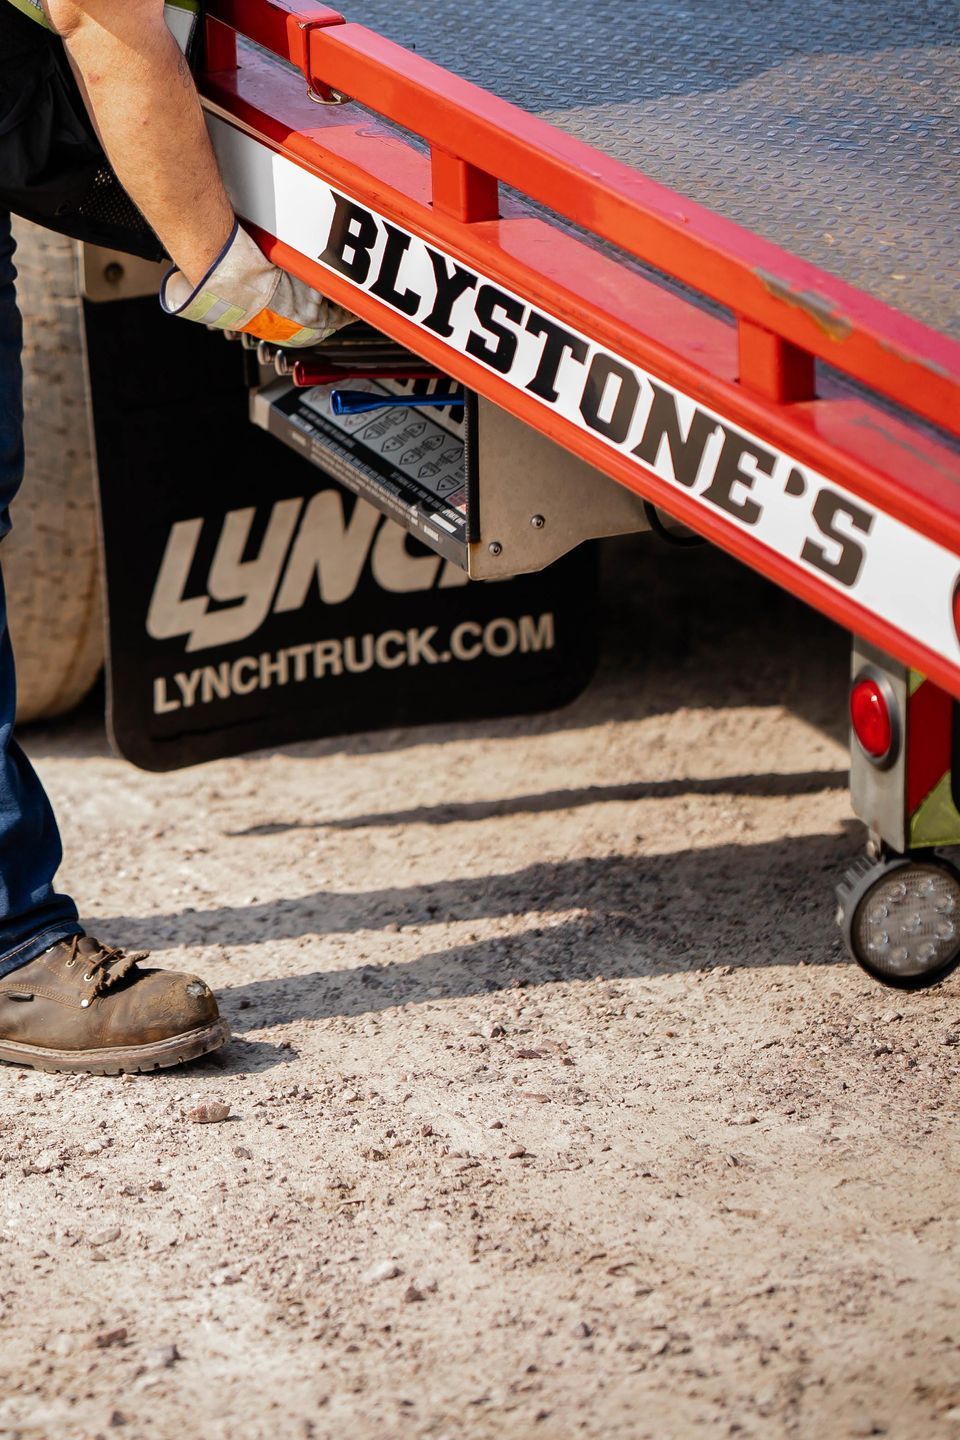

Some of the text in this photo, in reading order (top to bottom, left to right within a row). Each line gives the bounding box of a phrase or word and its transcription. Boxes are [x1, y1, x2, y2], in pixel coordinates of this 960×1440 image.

[318, 190, 877, 589] BLYSTONE'S
[146, 489, 515, 654] LYNC
[153, 613, 555, 715] LYNCHTRUCK.COM
